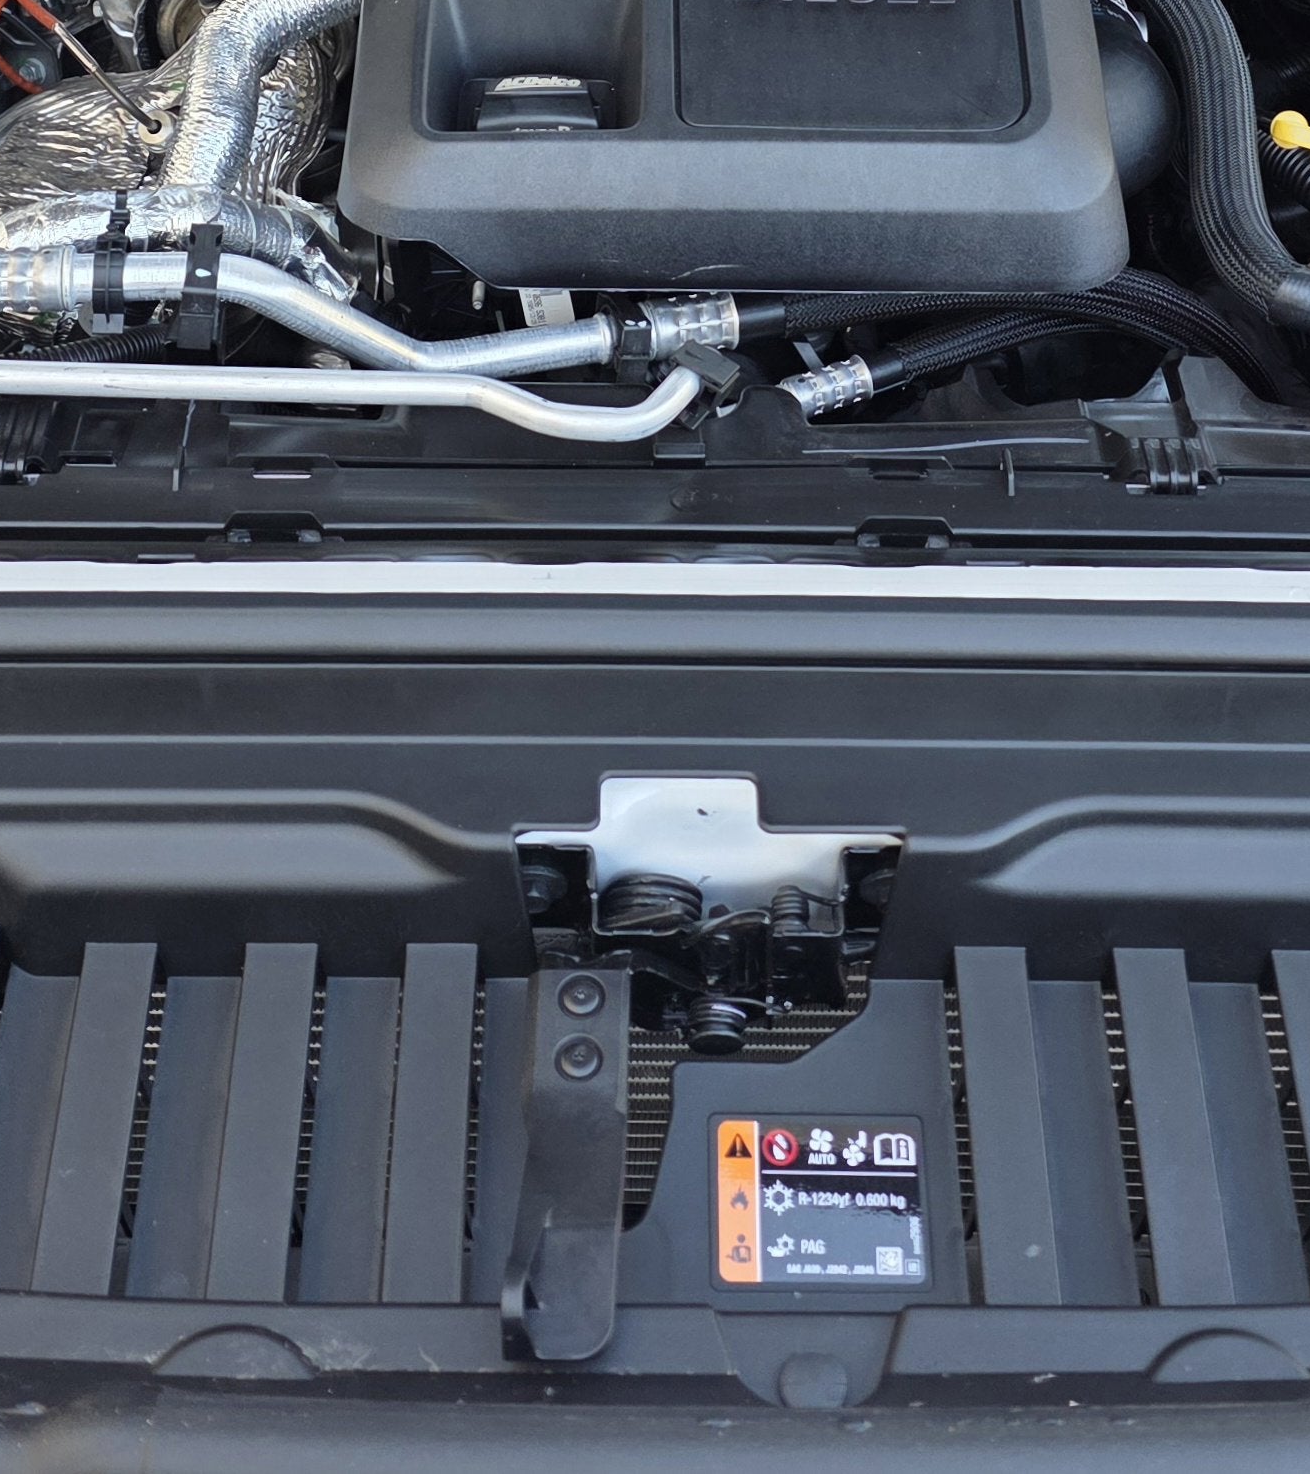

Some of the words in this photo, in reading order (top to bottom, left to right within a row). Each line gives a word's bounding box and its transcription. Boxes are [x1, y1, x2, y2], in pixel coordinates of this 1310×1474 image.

[494, 76, 582, 92] ACDelco
[808, 1152, 837, 1165] AUTO
[798, 1192, 851, 1209] R-1234yf
[855, 1192, 888, 1207] 0.600
[890, 1193, 907, 1210] kg
[800, 1239, 826, 1255] PAG
